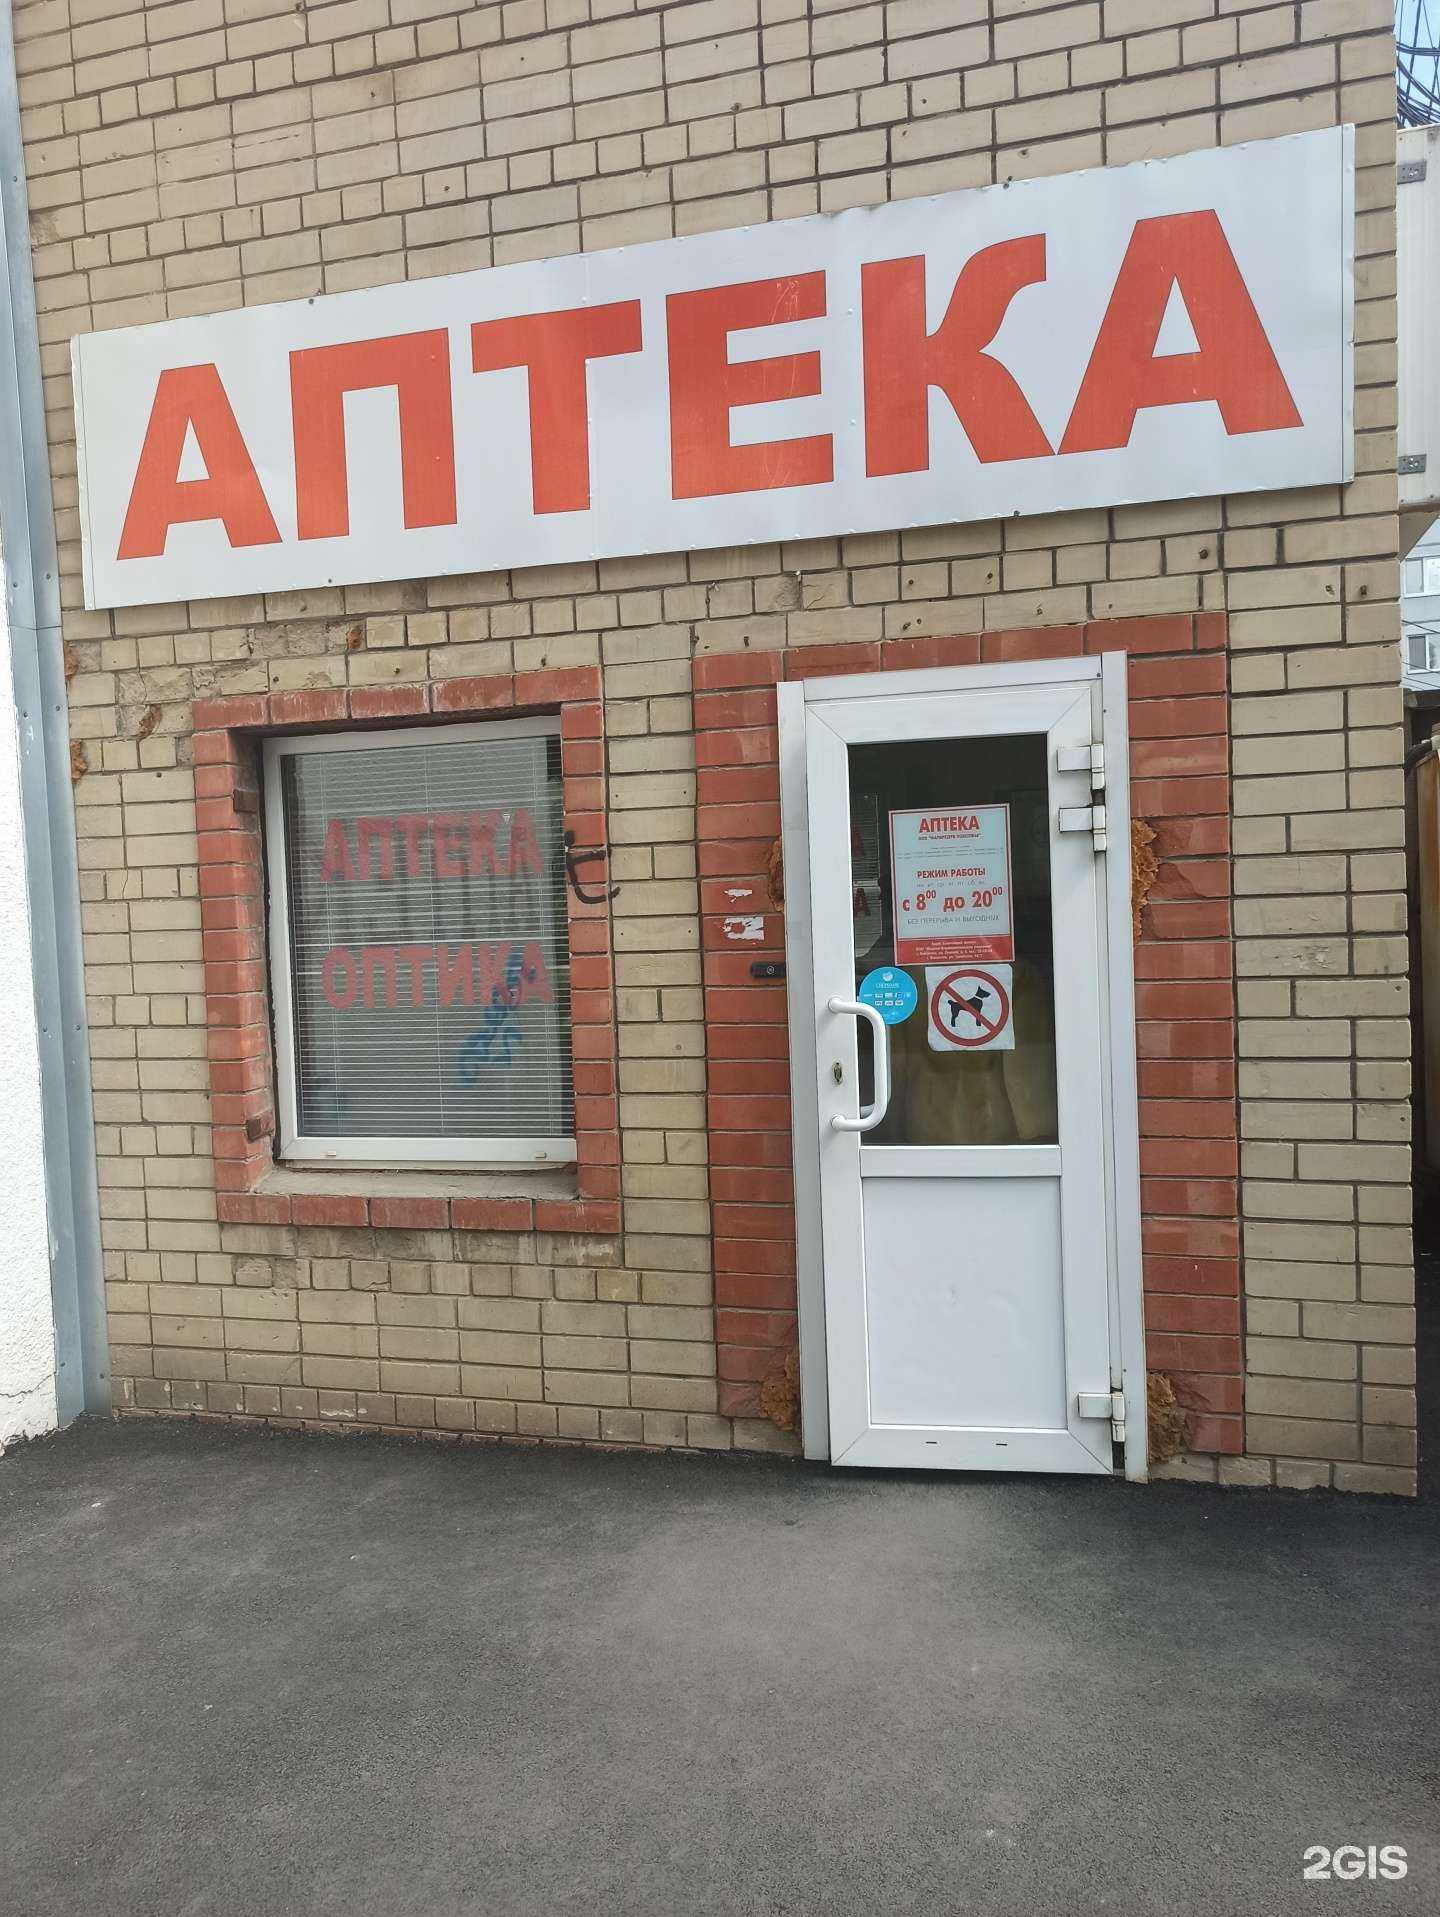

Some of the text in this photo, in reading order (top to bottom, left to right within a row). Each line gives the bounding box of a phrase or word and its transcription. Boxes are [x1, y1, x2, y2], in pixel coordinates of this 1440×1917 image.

[117, 209, 1304, 560] АПТЕКА
[320, 808, 544, 882] АПТЕКА
[919, 816, 980, 833] АПТЕКА
[917, 867, 986, 879] РЕЖИМ РАБОТЫ
[321, 940, 555, 1010] ОПТИКА
